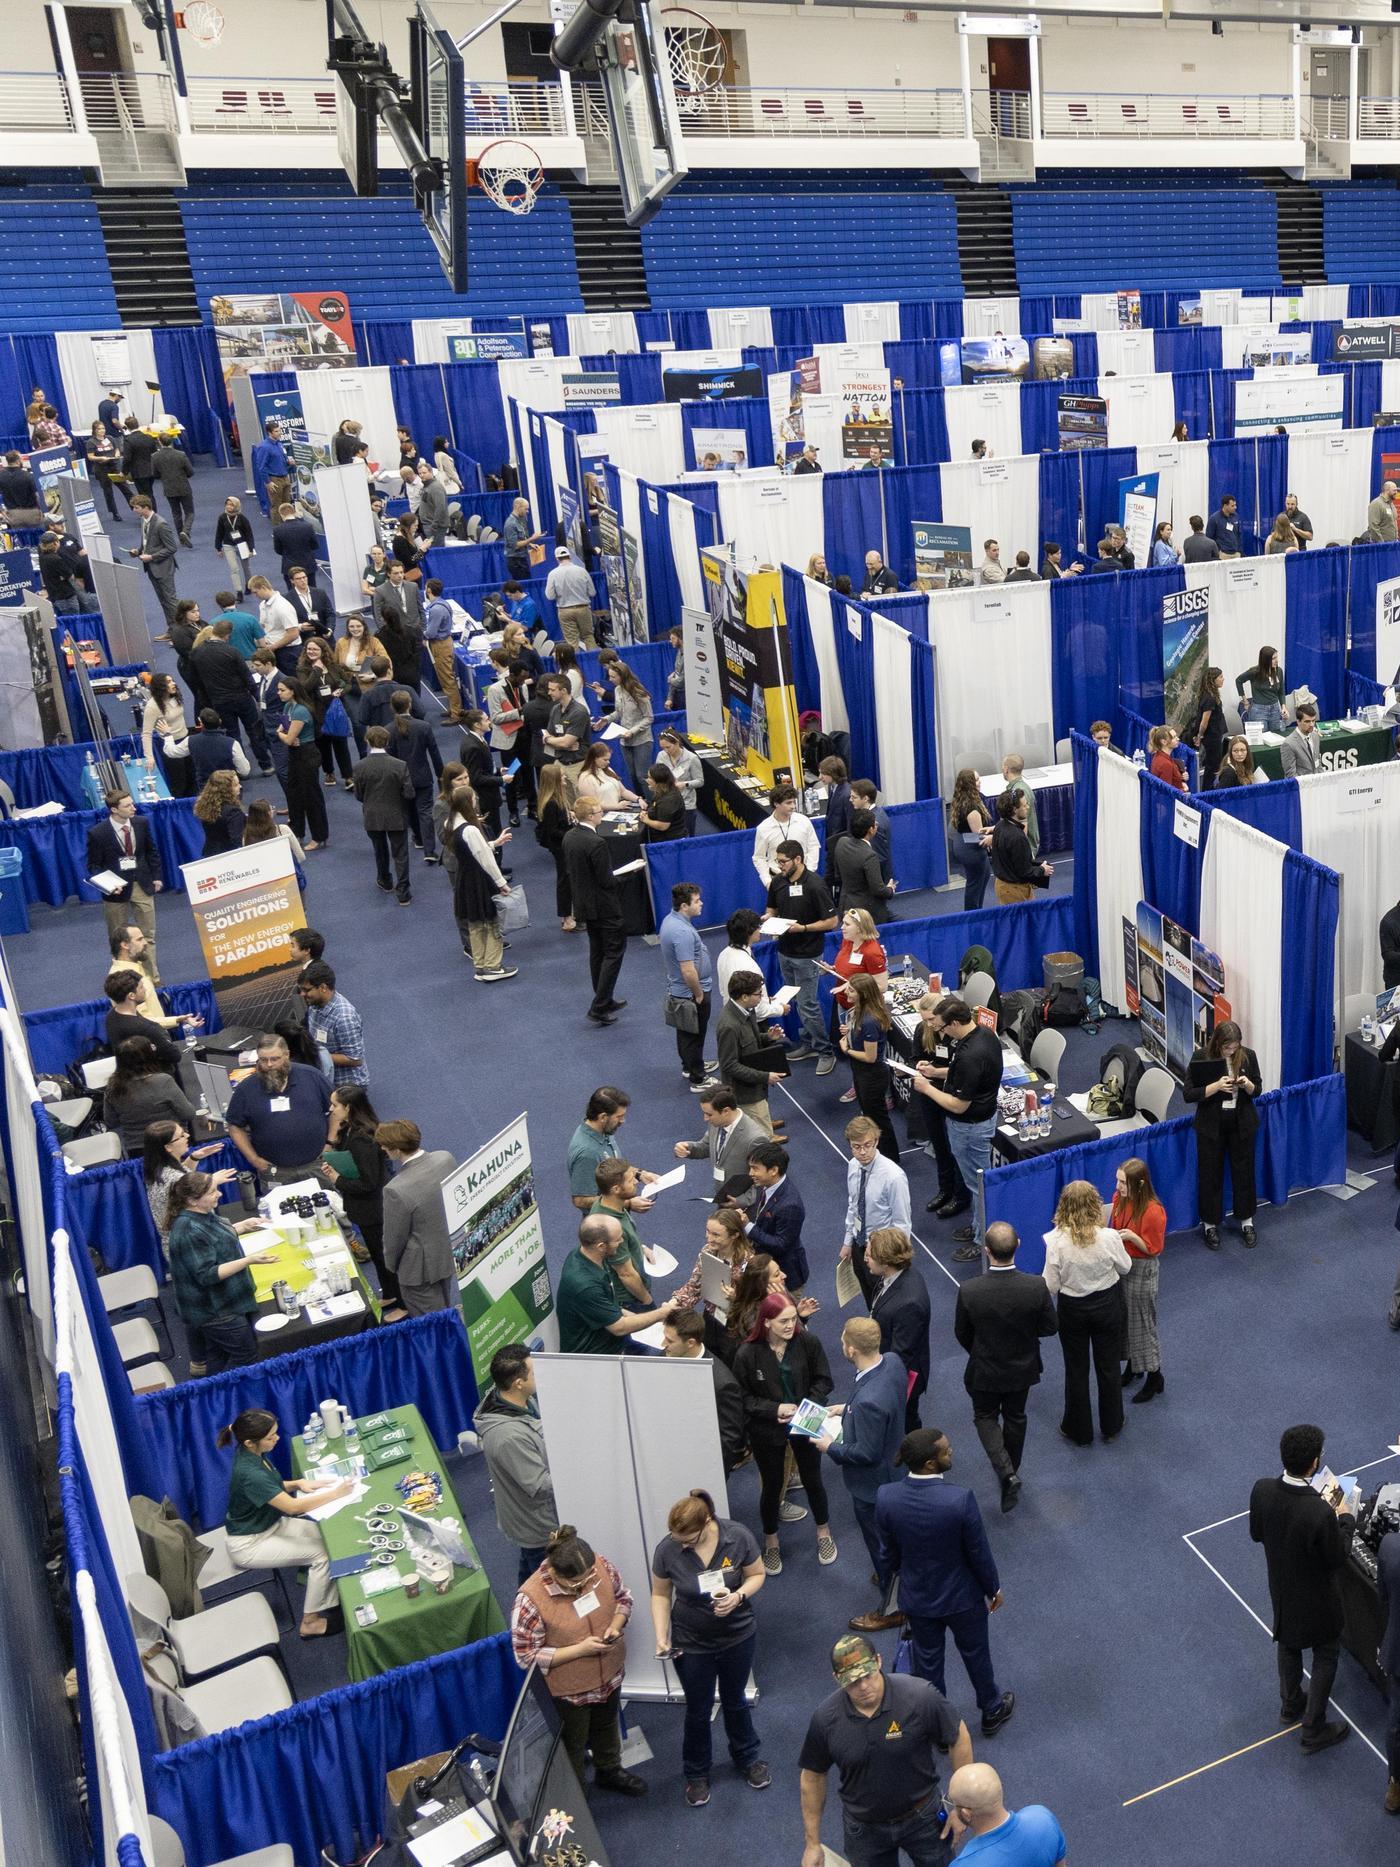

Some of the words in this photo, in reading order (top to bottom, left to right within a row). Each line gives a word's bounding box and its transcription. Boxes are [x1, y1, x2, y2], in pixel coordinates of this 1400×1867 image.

[477, 337, 508, 348] Adolfson
[485, 344, 515, 353] Peterson
[1352, 336, 1385, 346] ATWELL
[479, 349, 522, 358] Construction
[843, 392, 886, 402] NATION
[1176, 588, 1208, 615] USGS
[1166, 644, 1182, 669] Geologic
[1180, 624, 1196, 646] Hazards
[1320, 748, 1358, 771] SGS
[1357, 787, 1372, 796] Energy
[218, 870, 235, 880] HYDE
[218, 868, 261, 886] RENEWABLES
[204, 905, 236, 920] QUALITY
[236, 889, 287, 911] ENGINEERING
[206, 898, 289, 933] SOLUTIONS
[210, 933, 226, 943] FOR
[214, 943, 232, 954] THE
[233, 934, 255, 948] NEW
[256, 921, 294, 941] ENERGY
[1176, 959, 1191, 975] POWER
[466, 1140, 522, 1194] KAHUNA
[470, 1187, 486, 1202] ENERGY
[486, 1171, 502, 1187] PROJECT
[502, 1153, 524, 1175] EXECUTION
[490, 1248, 515, 1274] MORE
[514, 1224, 538, 1248] THAN
[518, 1258, 524, 1266] A
[524, 1240, 542, 1261] JOB.
